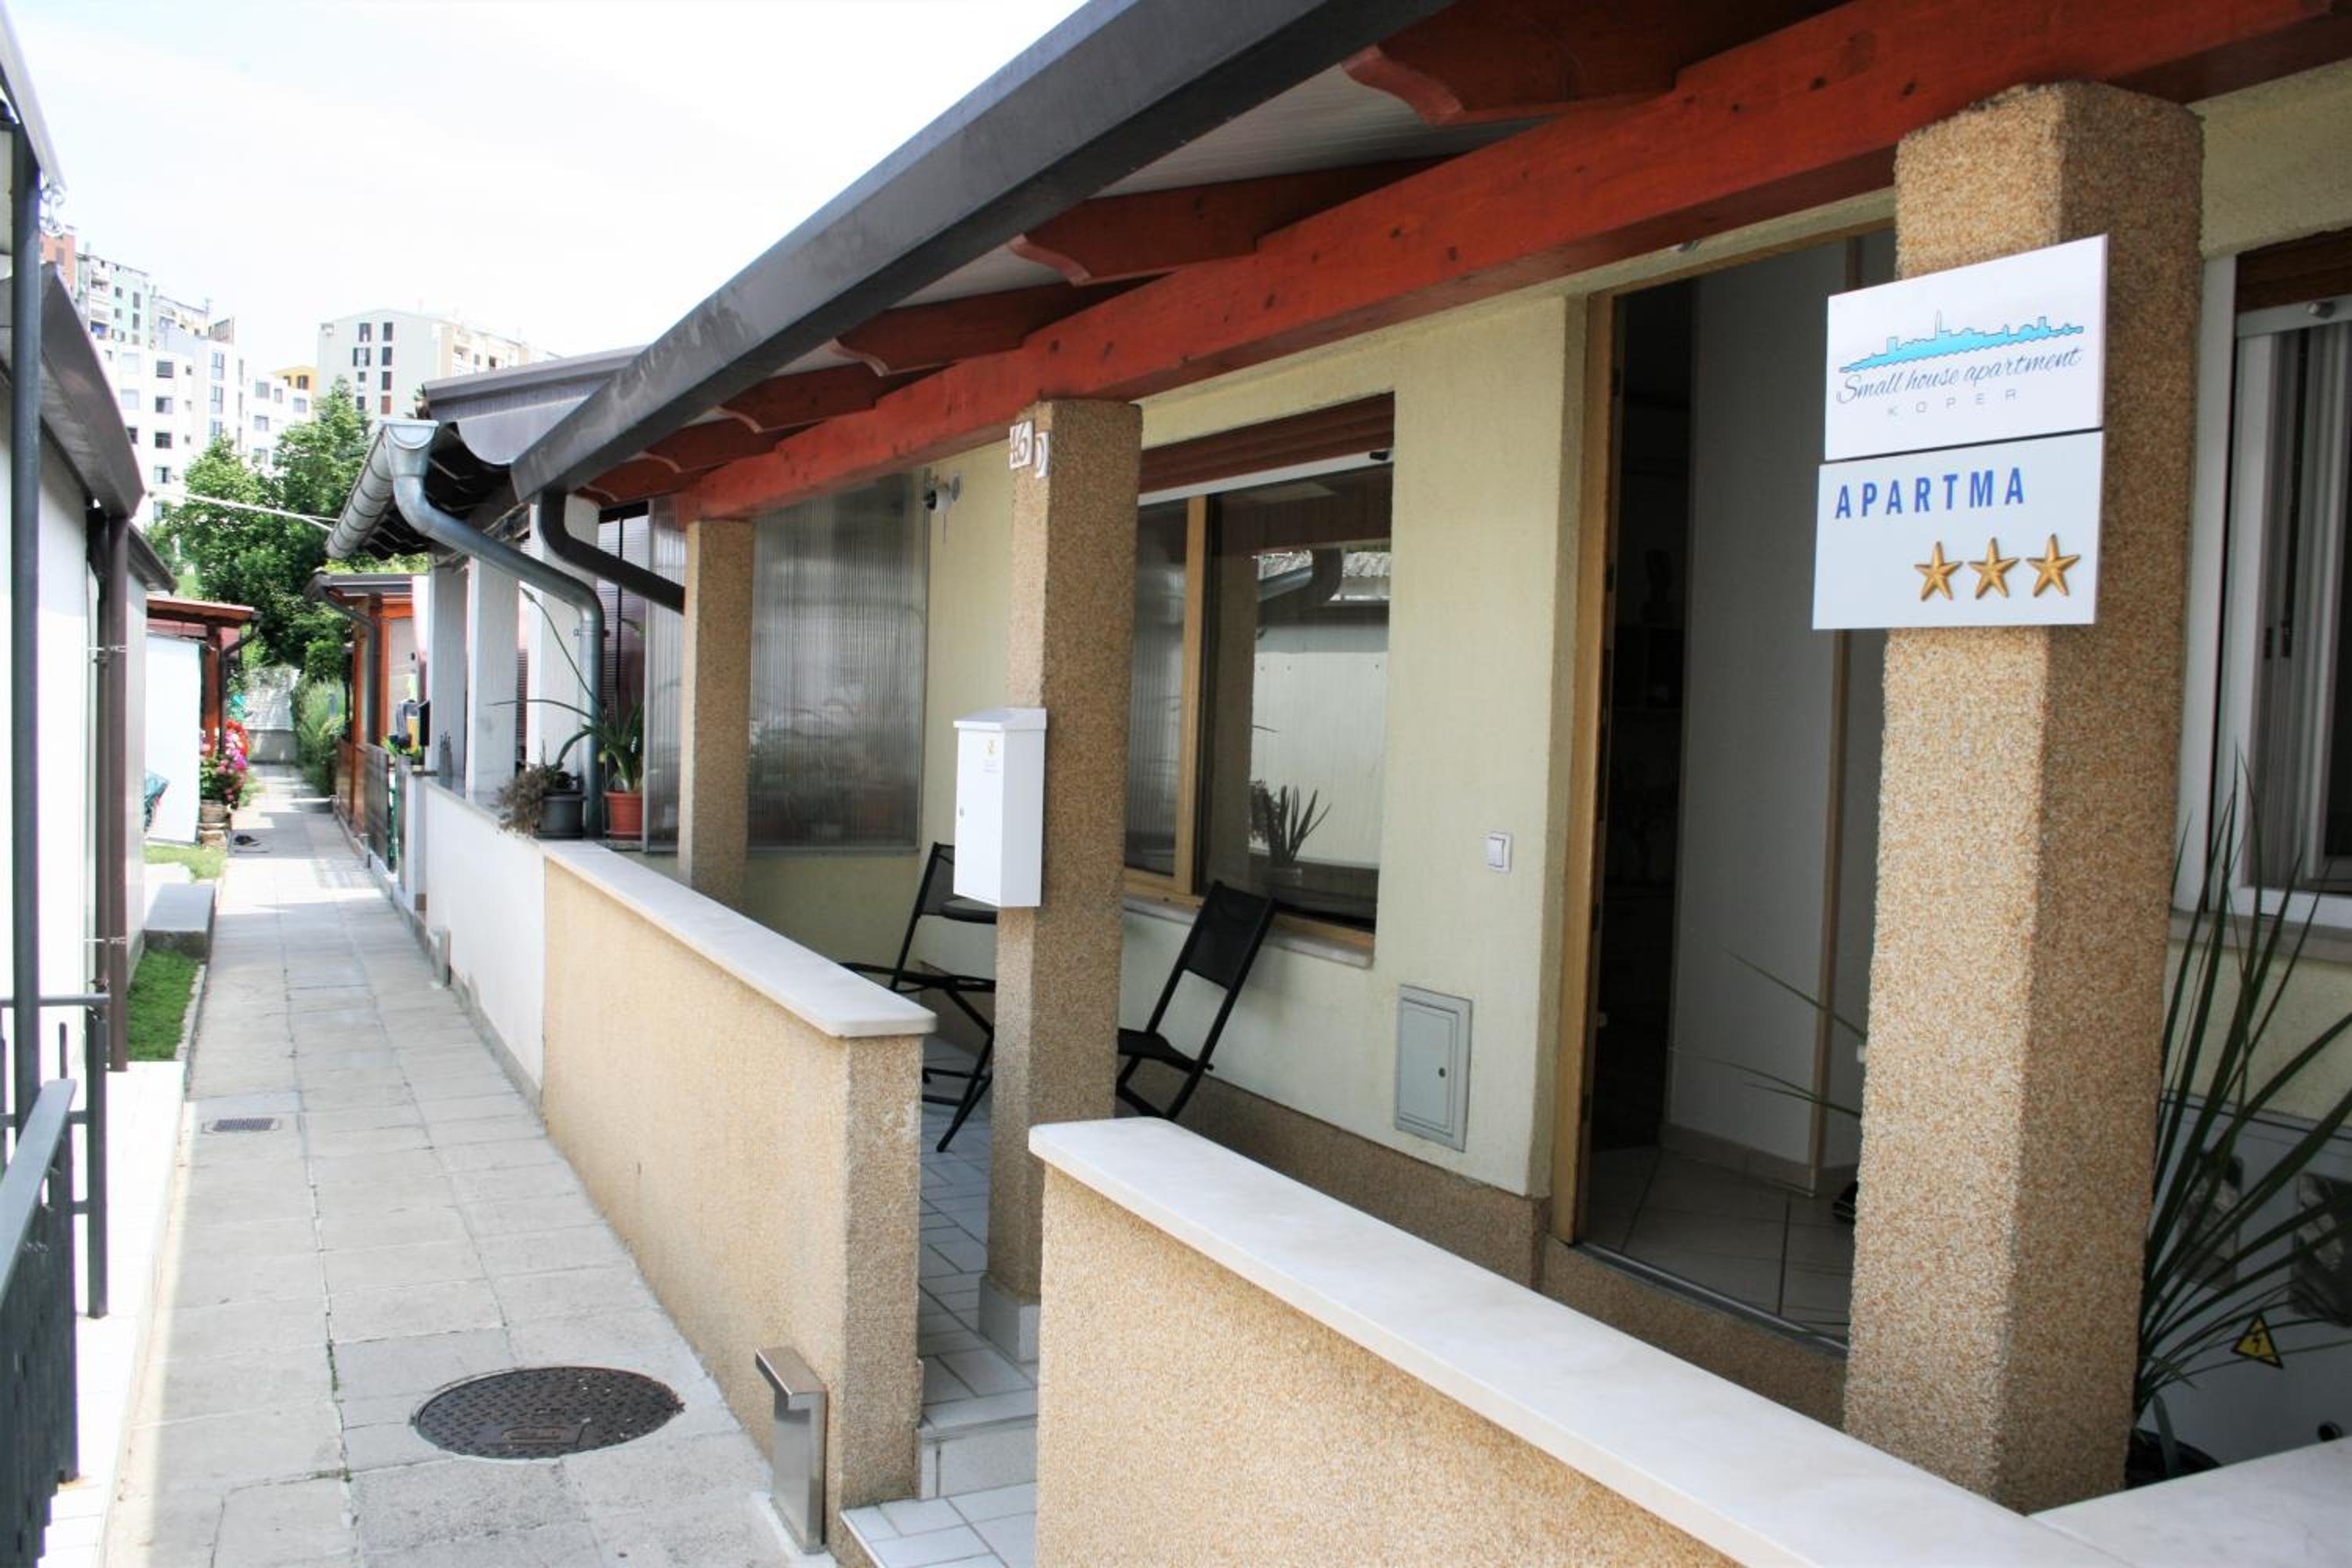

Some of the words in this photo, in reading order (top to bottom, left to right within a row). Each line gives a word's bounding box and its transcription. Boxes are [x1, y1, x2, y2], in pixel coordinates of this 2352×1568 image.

[1836, 372, 1904, 404] Small
[1905, 369, 1959, 392] house
[1963, 345, 2082, 387] apartment
[1887, 388, 2016, 416] KOPER
[1835, 466, 2024, 519] APARTMA
